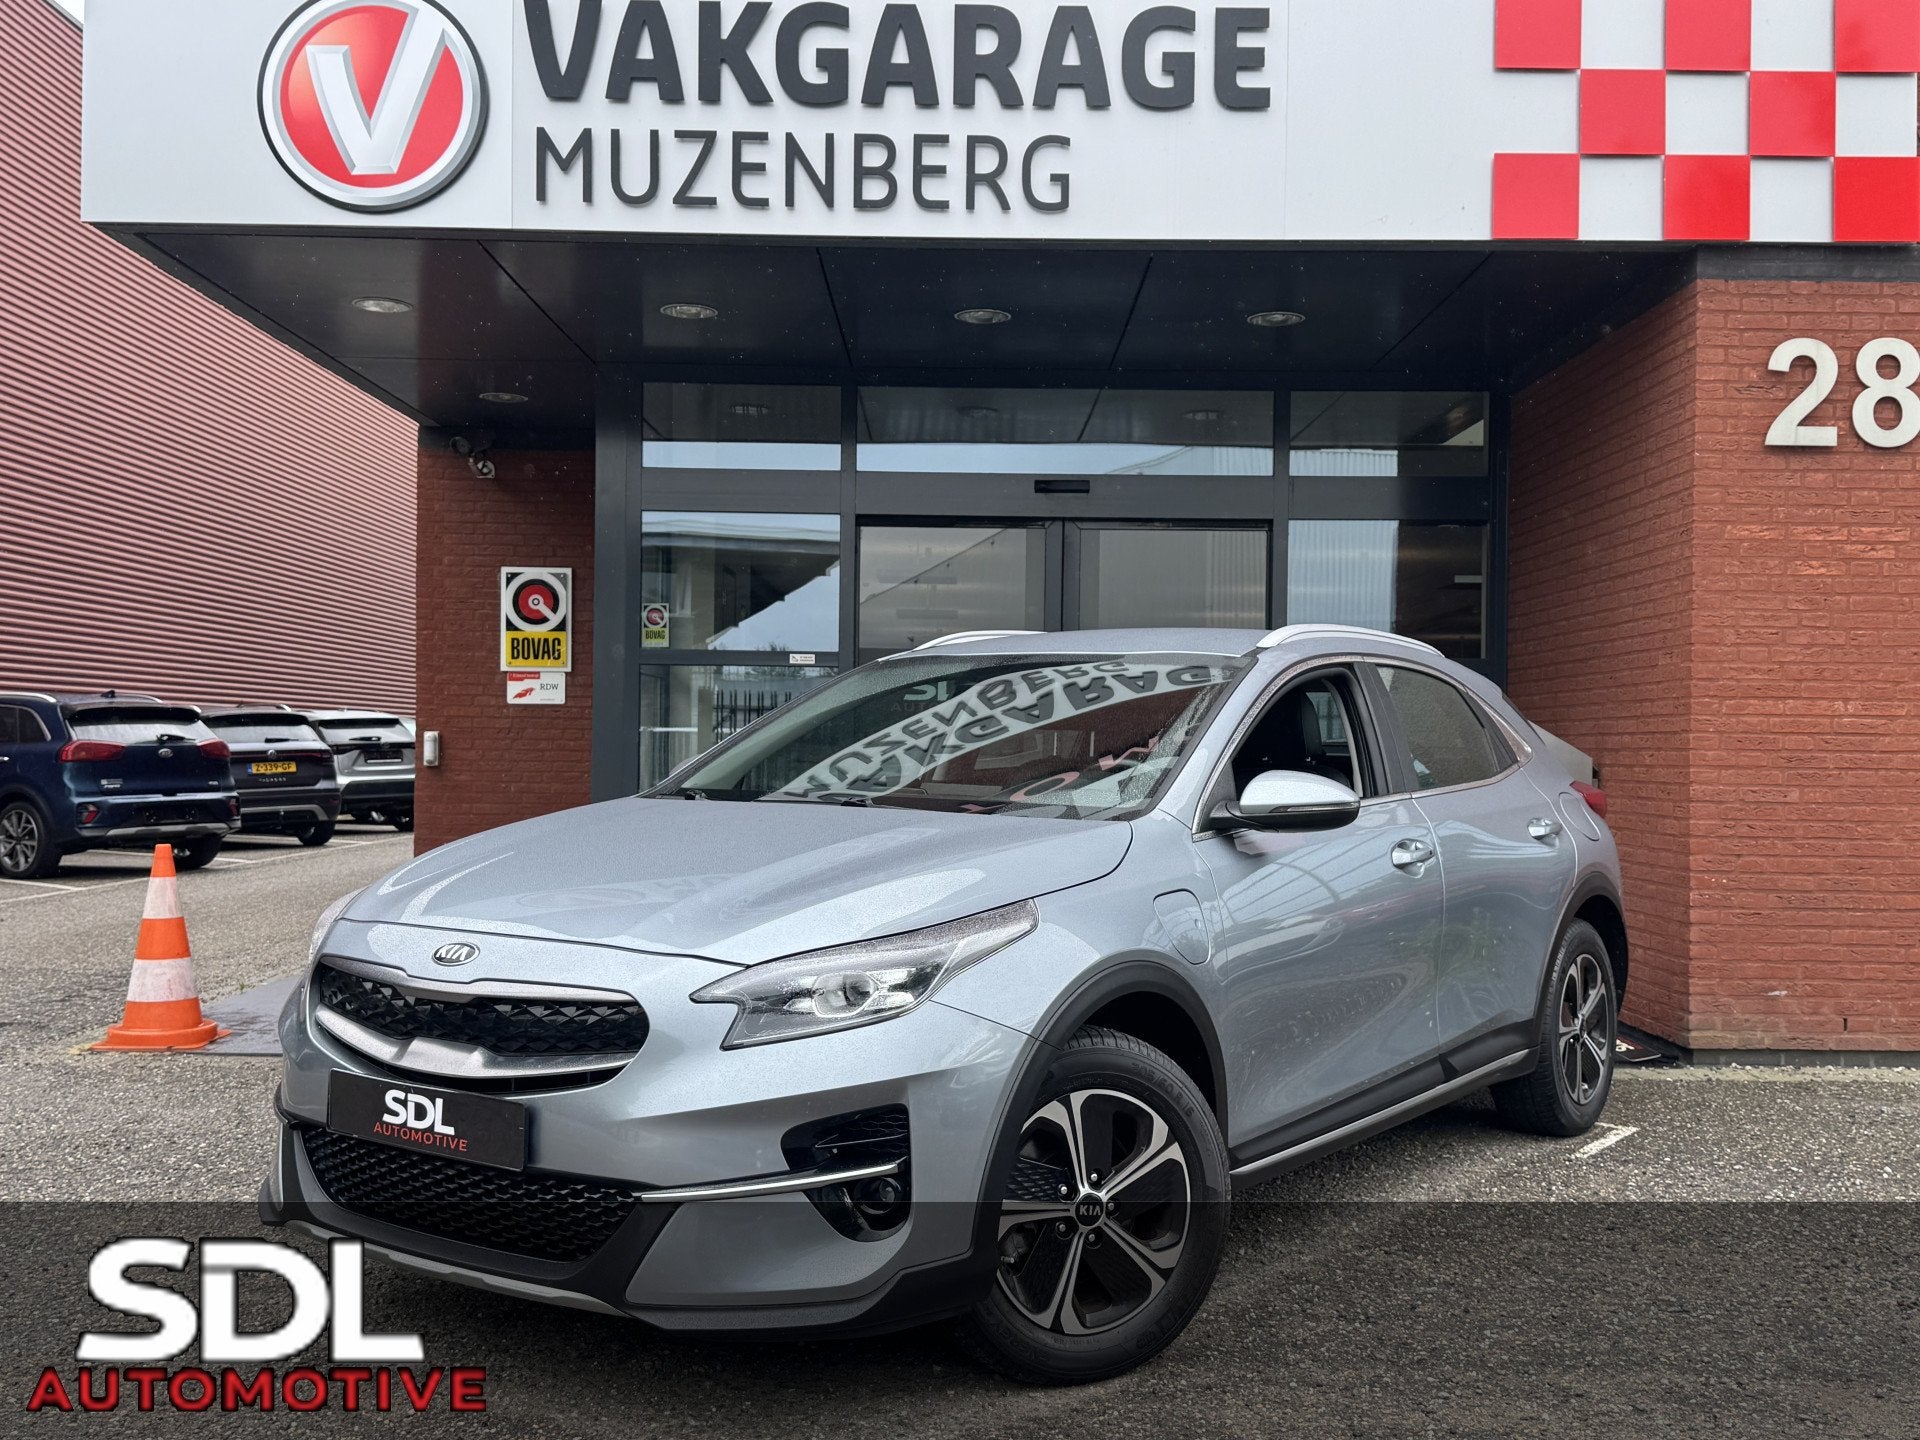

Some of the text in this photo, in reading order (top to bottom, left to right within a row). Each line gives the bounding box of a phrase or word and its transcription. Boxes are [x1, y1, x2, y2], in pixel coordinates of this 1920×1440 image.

[523, 0, 1271, 111] VAKGARAGE
[535, 127, 1071, 211] MUZENBERG
[1765, 337, 1920, 448] 28
[645, 629, 666, 640] BOVAG
[511, 637, 561, 660] BOVAG
[540, 683, 559, 691] RDW
[436, 943, 470, 960] KIA
[382, 1089, 455, 1135] SDL
[373, 1122, 468, 1151] AUTOMOTIVE
[1079, 1204, 1101, 1216] KIA
